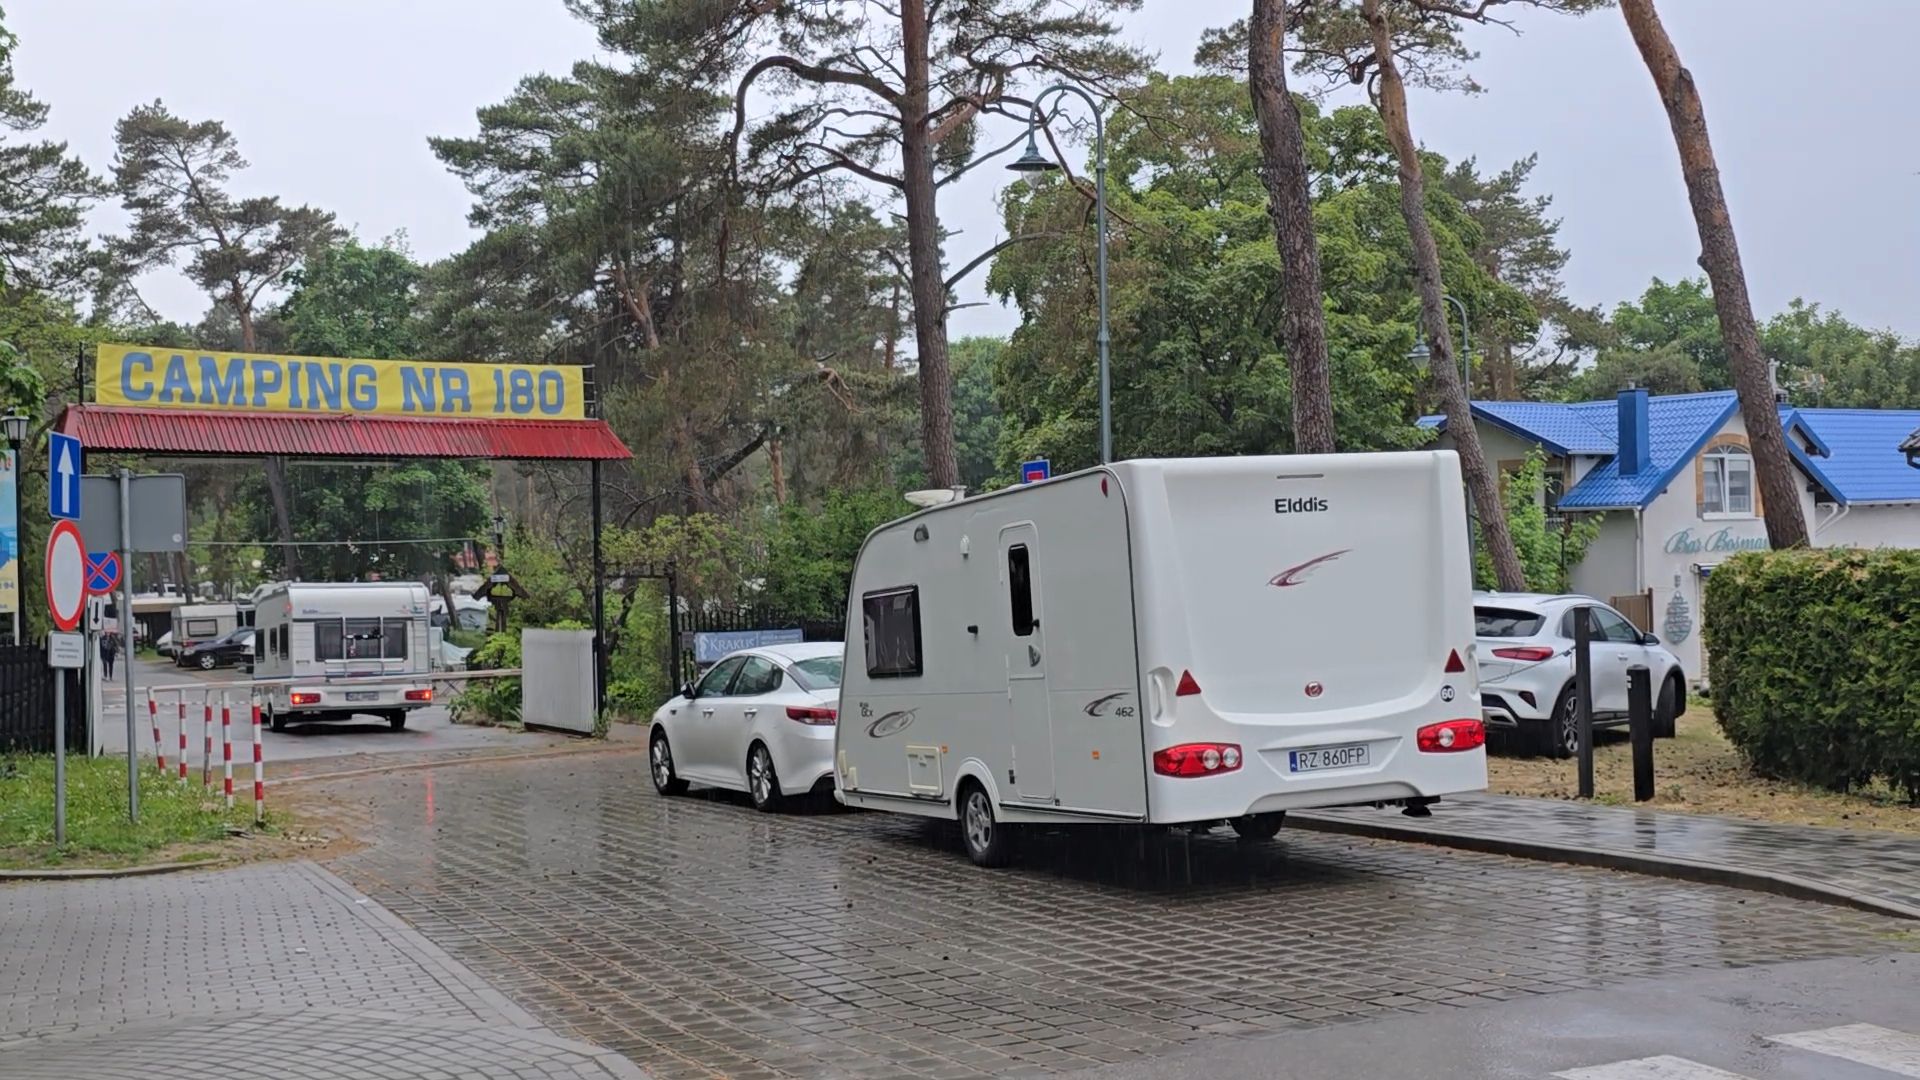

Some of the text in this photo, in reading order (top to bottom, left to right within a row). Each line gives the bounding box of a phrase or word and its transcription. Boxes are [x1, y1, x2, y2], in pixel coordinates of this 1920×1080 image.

[120, 352, 565, 415] CAMPING NR 180
[1274, 497, 1328, 514] Elddis
[1664, 528, 1701, 554] Bar
[1441, 687, 1454, 699] 60
[1115, 706, 1135, 718] 462
[1299, 748, 1365, 769] RZ 860FP
